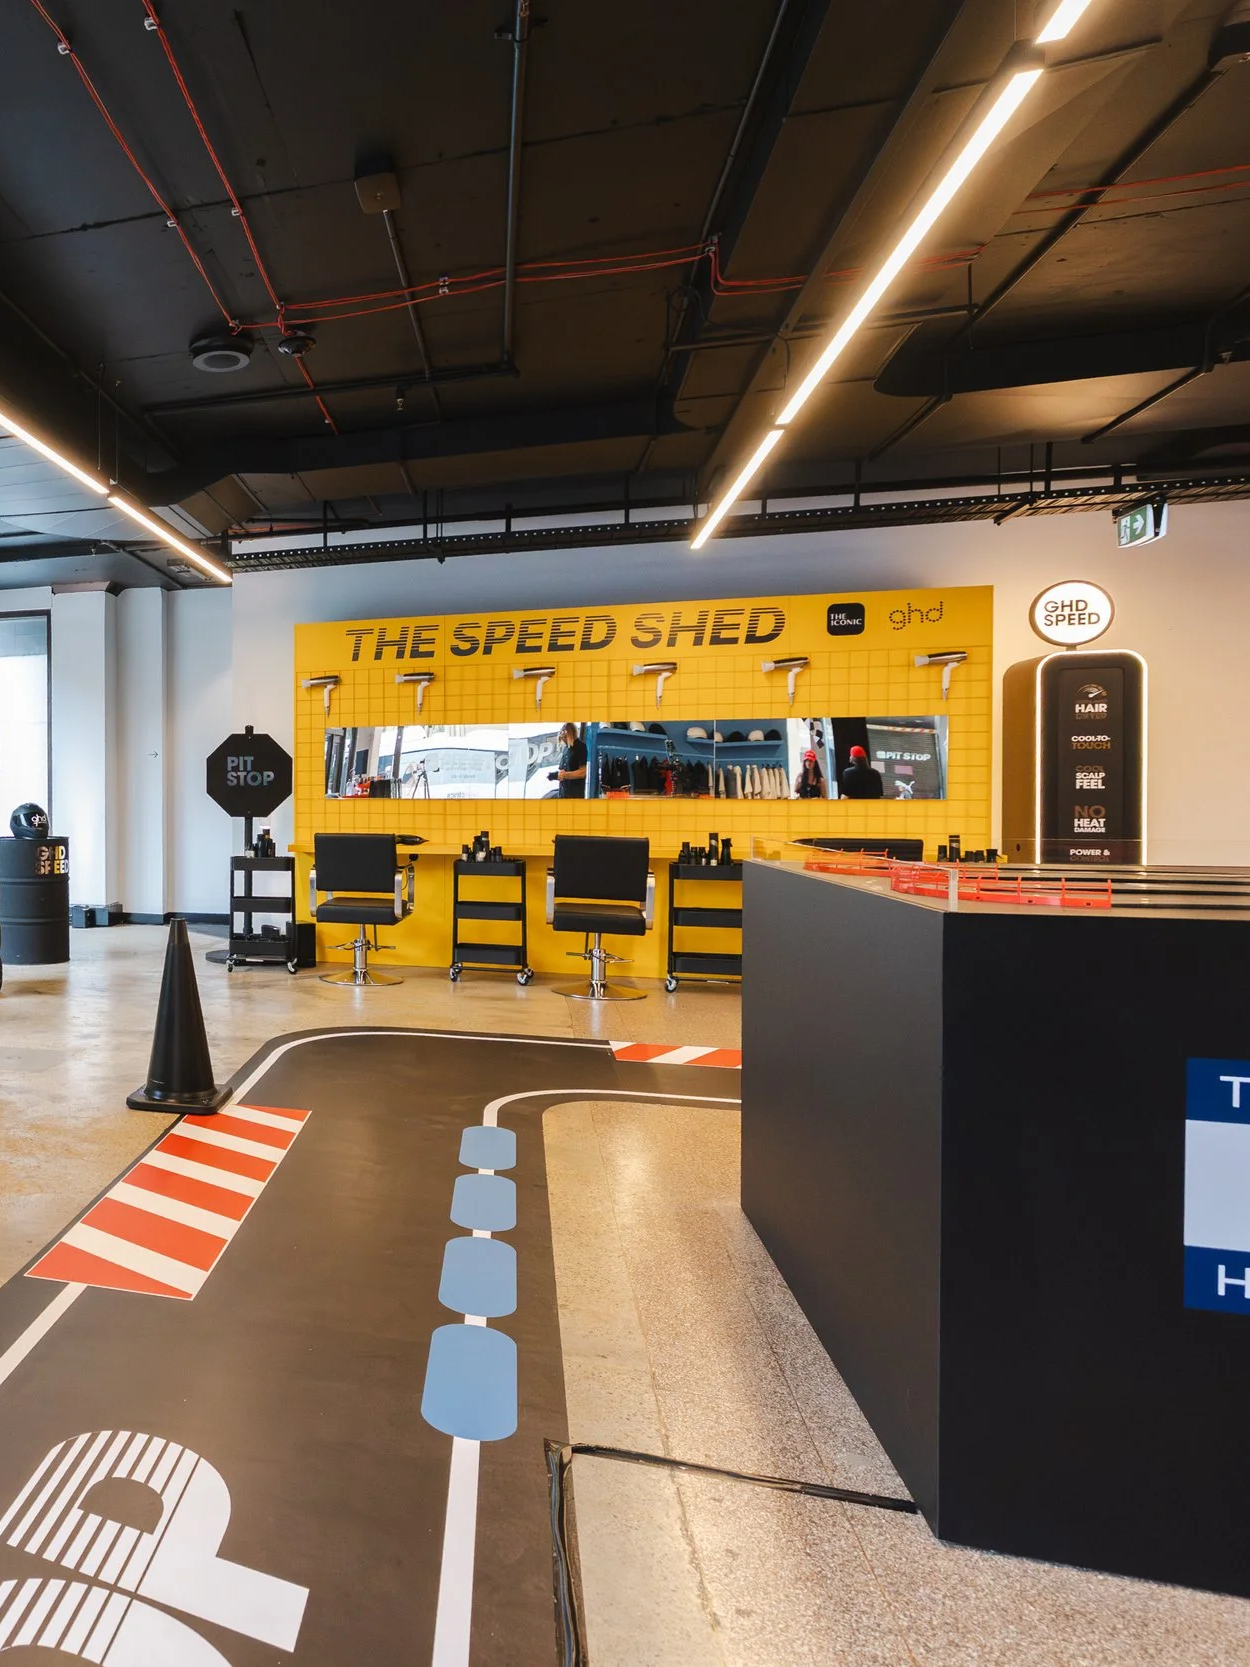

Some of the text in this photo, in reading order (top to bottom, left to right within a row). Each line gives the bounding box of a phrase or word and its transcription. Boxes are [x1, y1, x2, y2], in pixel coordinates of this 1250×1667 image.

[1043, 599, 1088, 613] GHD
[830, 612, 847, 620] THE
[888, 600, 944, 631] ghd
[1043, 612, 1101, 627] SPEED
[830, 618, 863, 627] ICONIC
[345, 606, 788, 662] THE SPEED SHED
[1075, 703, 1108, 713] HAIR
[1071, 742, 1111, 750] TOUCH
[886, 751, 931, 761] PIT STOP
[227, 756, 254, 771] PIT
[226, 771, 275, 787] STOP
[1075, 779, 1106, 789] FEEL
[1074, 805, 1106, 818] NO
[1074, 818, 1106, 827] HEAT
